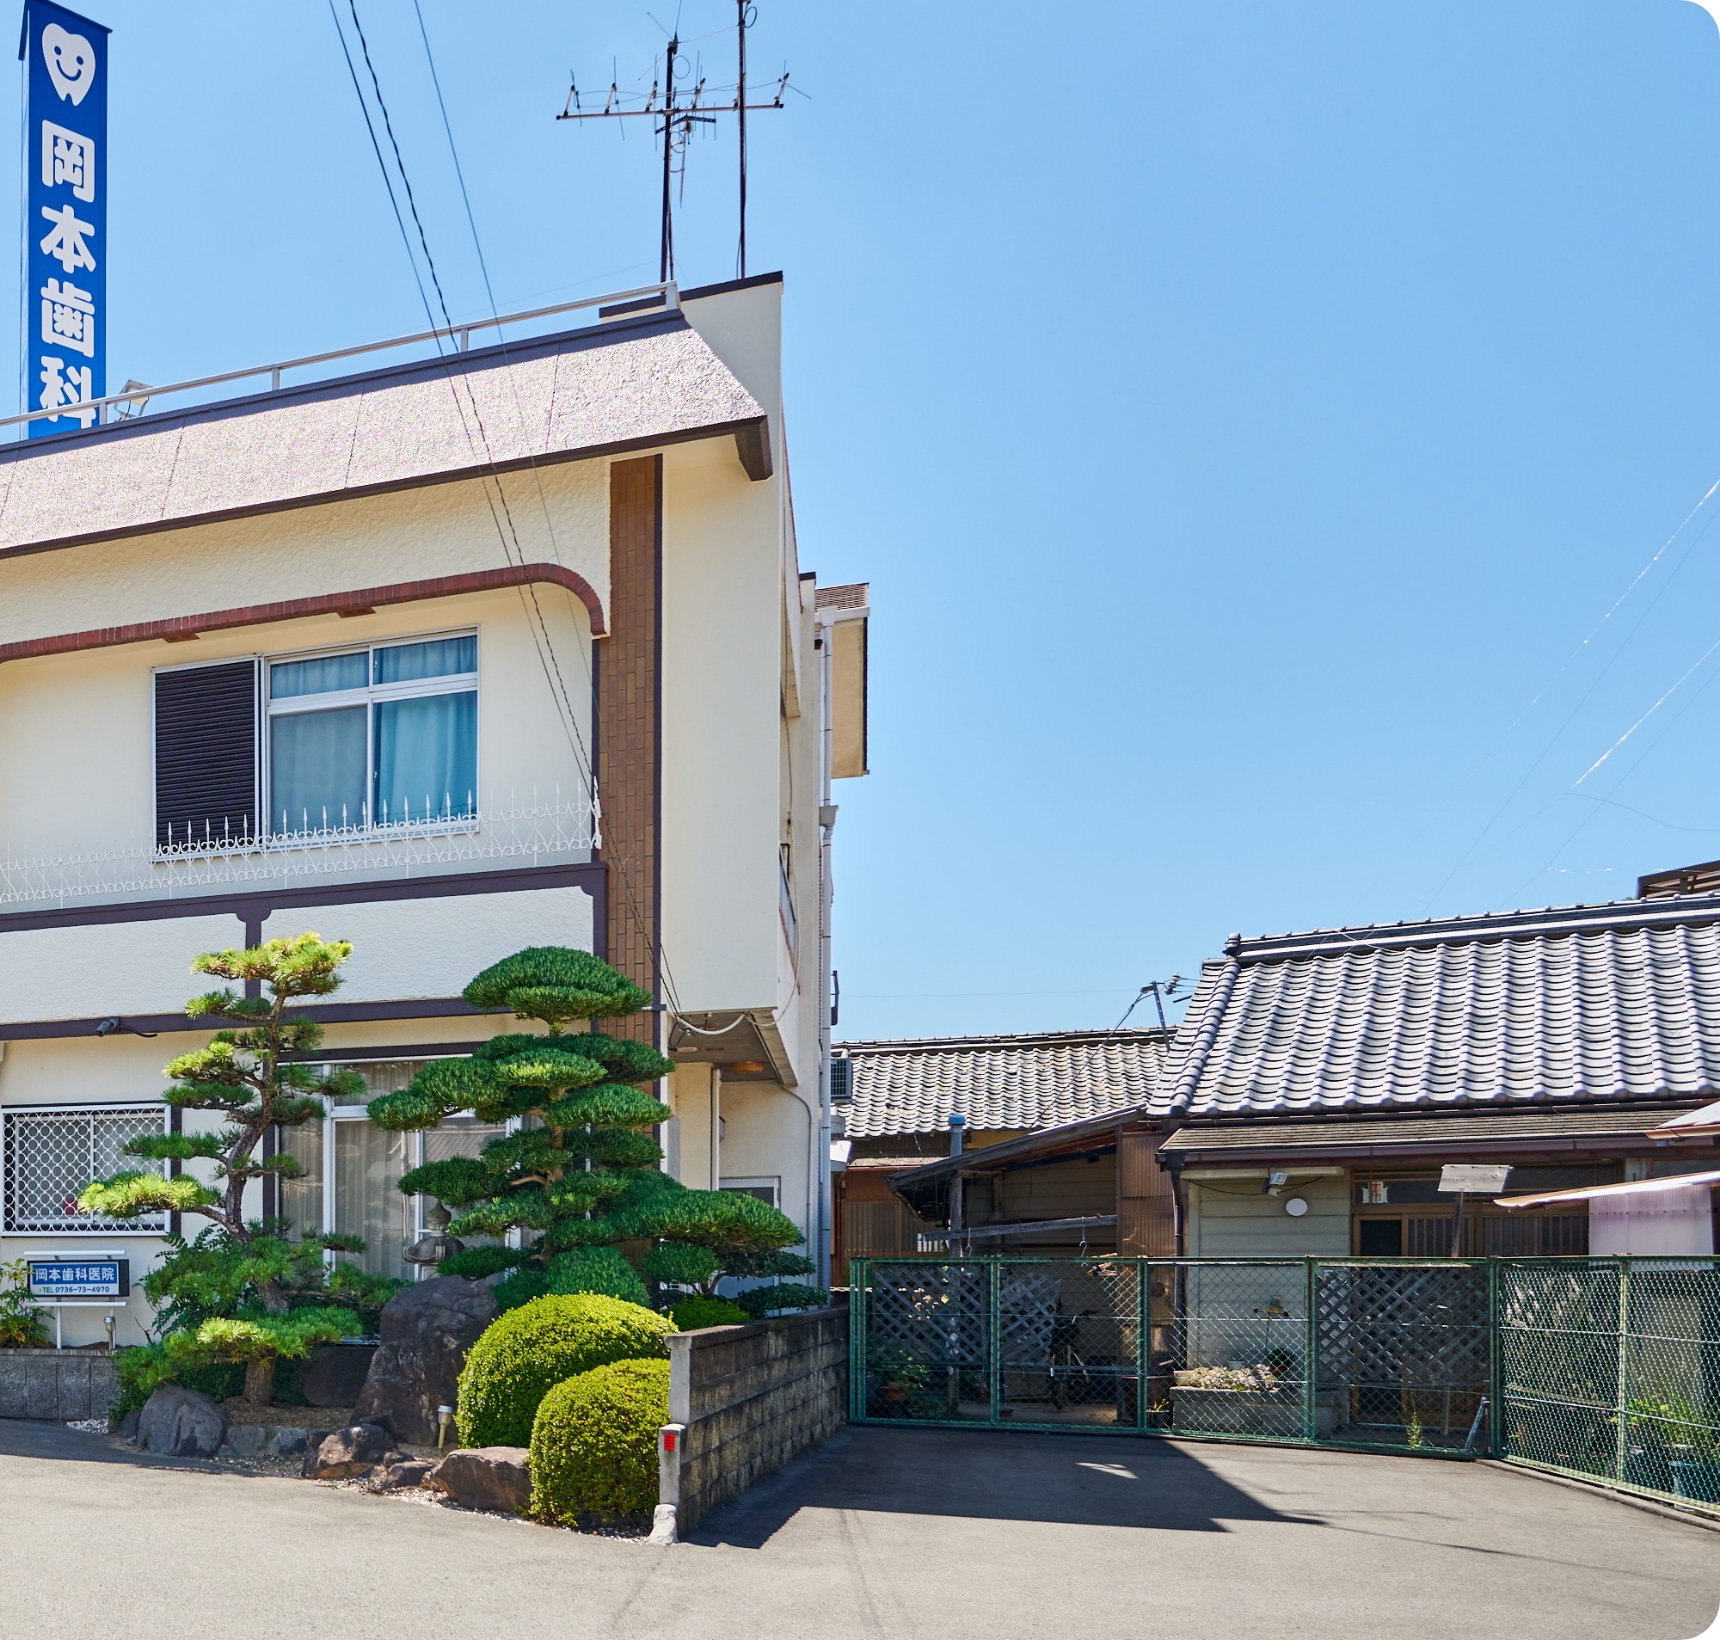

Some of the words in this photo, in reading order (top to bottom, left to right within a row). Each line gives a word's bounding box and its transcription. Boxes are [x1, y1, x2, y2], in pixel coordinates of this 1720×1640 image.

[40, 119, 97, 430] 岡本歯科
[35, 1267, 114, 1281] 岡本歯科医院
